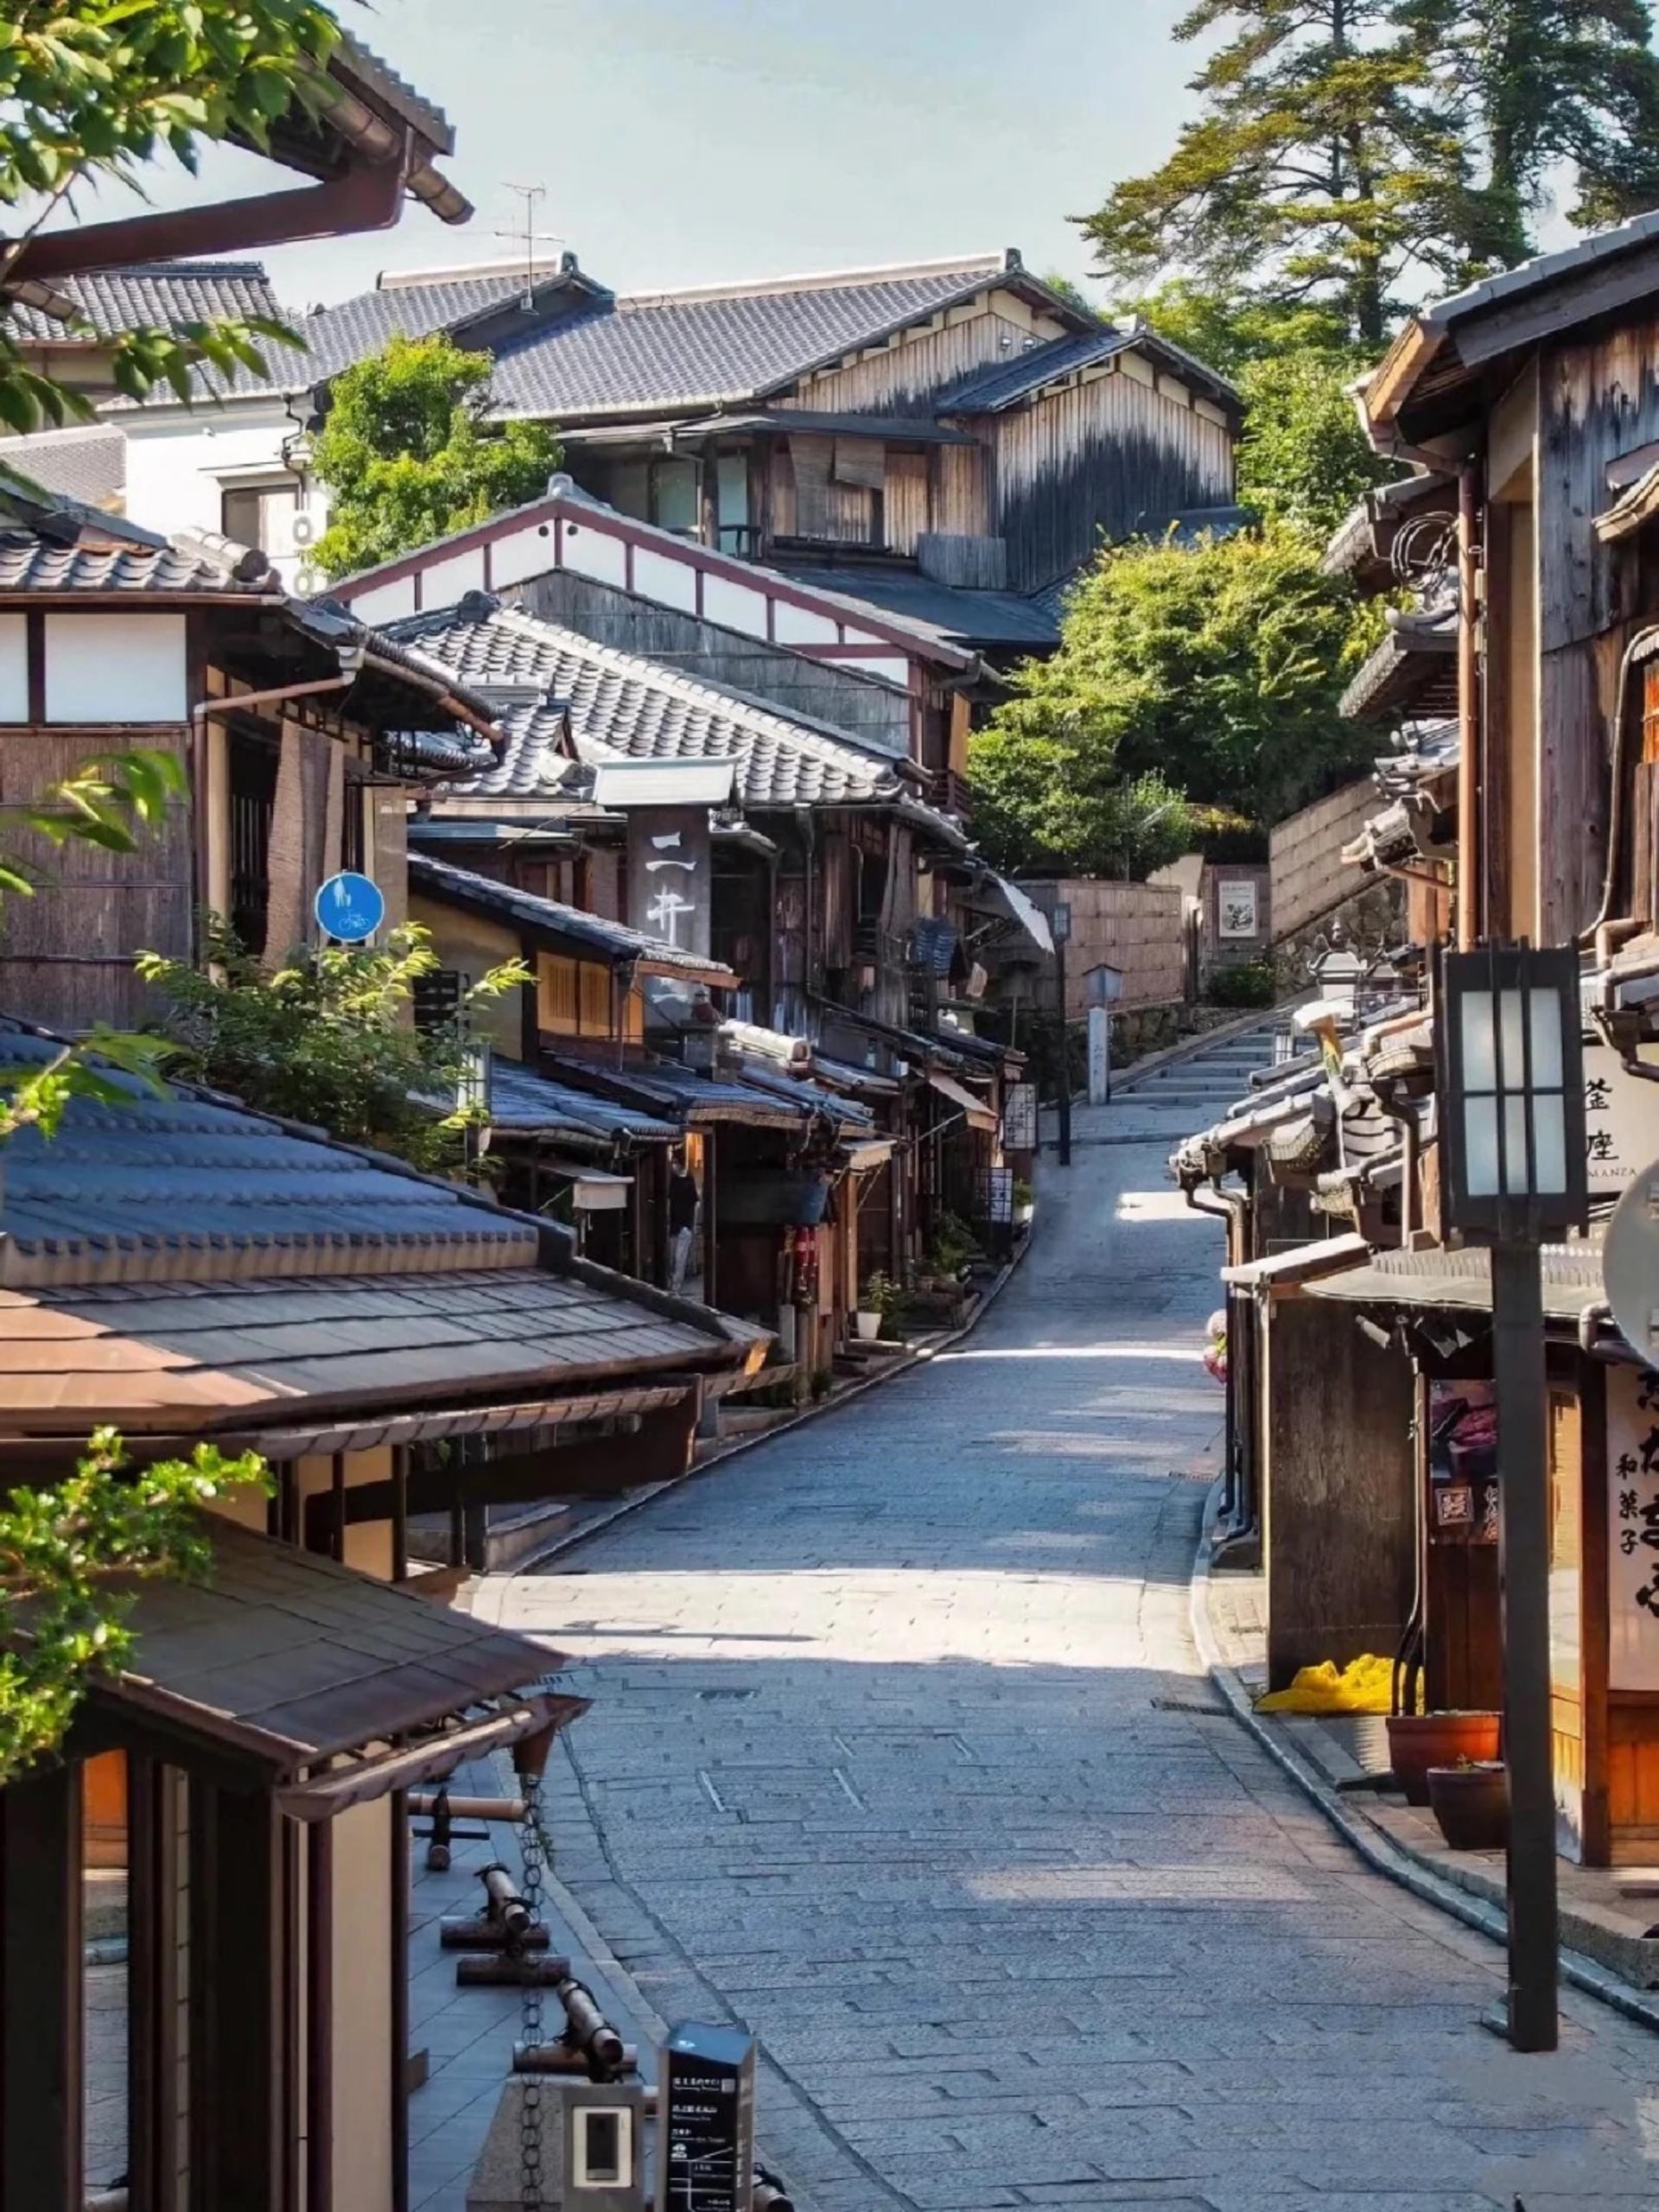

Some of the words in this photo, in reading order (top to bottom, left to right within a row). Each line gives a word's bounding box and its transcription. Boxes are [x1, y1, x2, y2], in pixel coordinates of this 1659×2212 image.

[1586, 1078, 1620, 1160] 釜座
[1615, 1453, 1638, 1555] 和菓子
